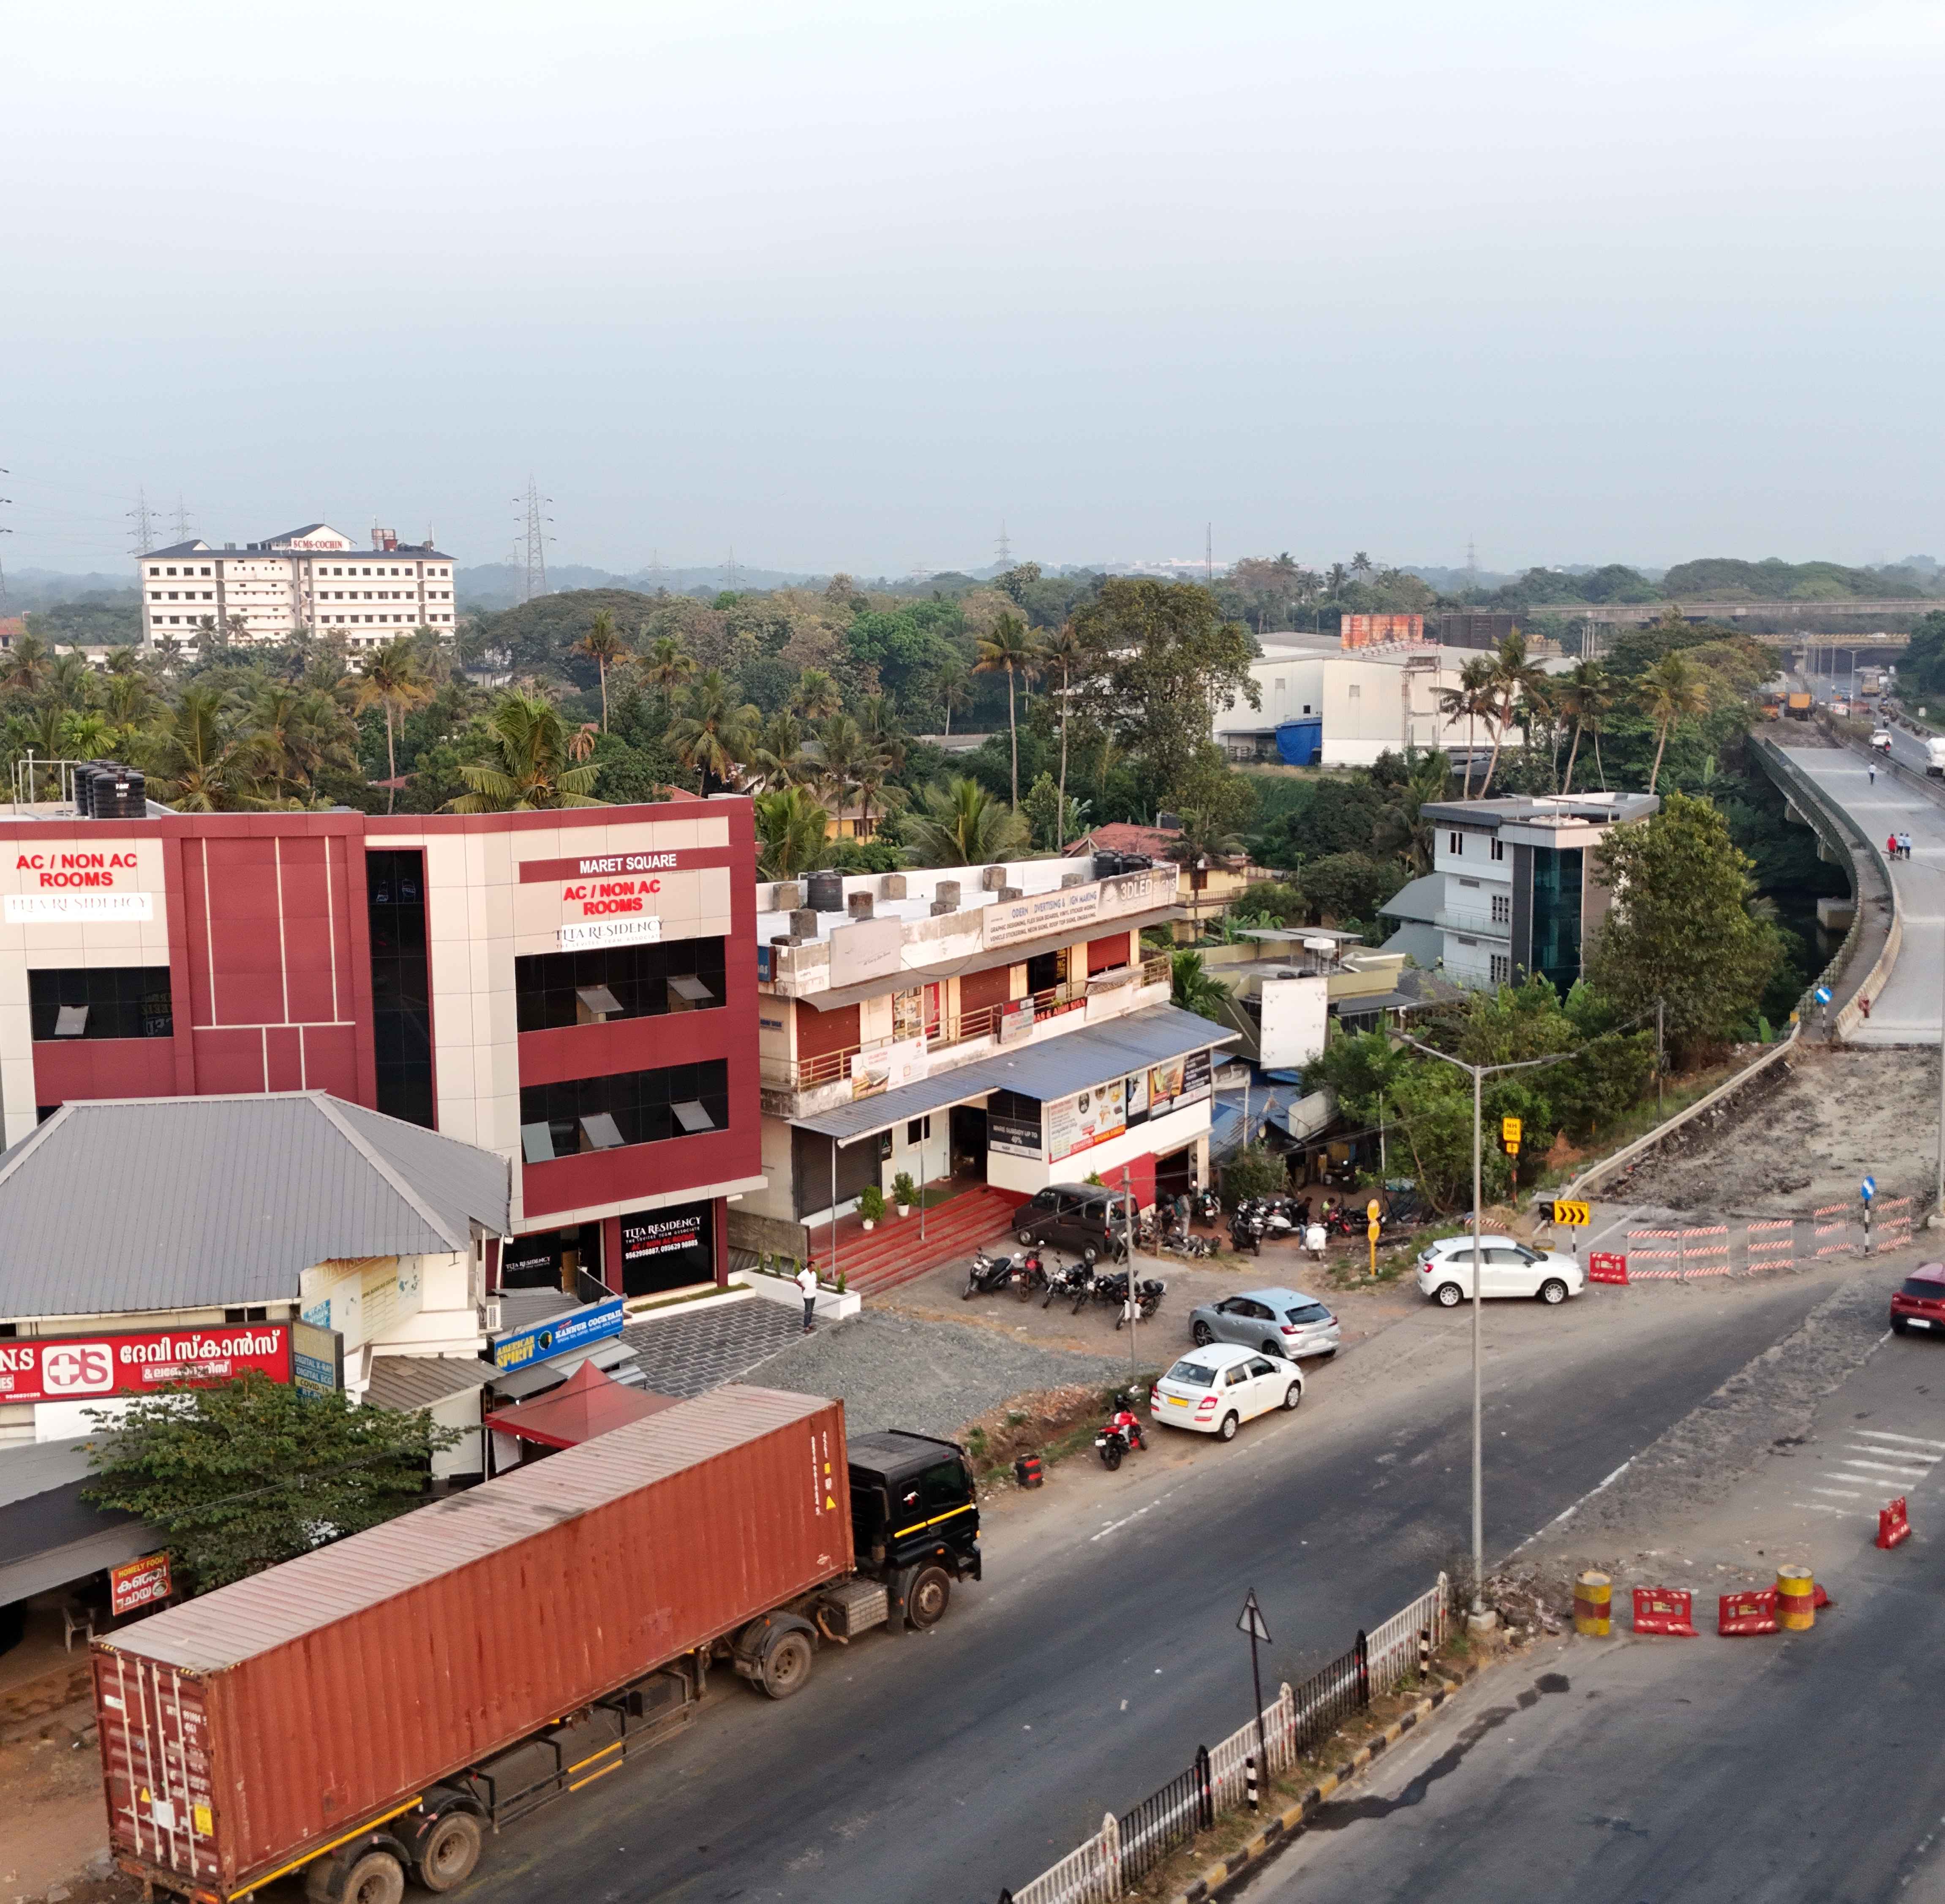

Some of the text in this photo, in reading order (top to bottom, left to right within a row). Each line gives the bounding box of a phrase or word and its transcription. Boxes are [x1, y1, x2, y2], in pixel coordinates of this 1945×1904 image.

[294, 540, 342, 549] SCMS-COCHIN
[16, 855, 44, 869] AC
[62, 854, 104, 868] NON
[109, 853, 137, 868] AC
[580, 854, 677, 874] MARET SQUARE
[40, 871, 113, 887] ROOMS
[564, 885, 587, 901] AC
[600, 881, 635, 898] NON
[638, 879, 661, 894] AC
[583, 897, 643, 915] ROOMS
[589, 919, 665, 939] RESIDENCY
[1071, 998, 1086, 1011] SIGN
[648, 1216, 702, 1234] RESIDENCY
[631, 1243, 640, 1251] AC
[646, 1239, 661, 1248] NON
[673, 1233, 696, 1242] ROOMS
[555, 1322, 587, 1339] KANNUR
[588, 1309, 623, 1326] COCKTAIL
[120, 1336, 171, 1363] ദേവി
[175, 1329, 281, 1360] സ്കാൻസ്
[295, 1354, 332, 1373] DIGITAL X-RAY
[497, 1344, 533, 1368] SPIRIT
[296, 1366, 332, 1385] DIGITAL ECG
[300, 1379, 329, 1393] COVID-19
[118, 1556, 164, 1578] HOMELY FOOD
